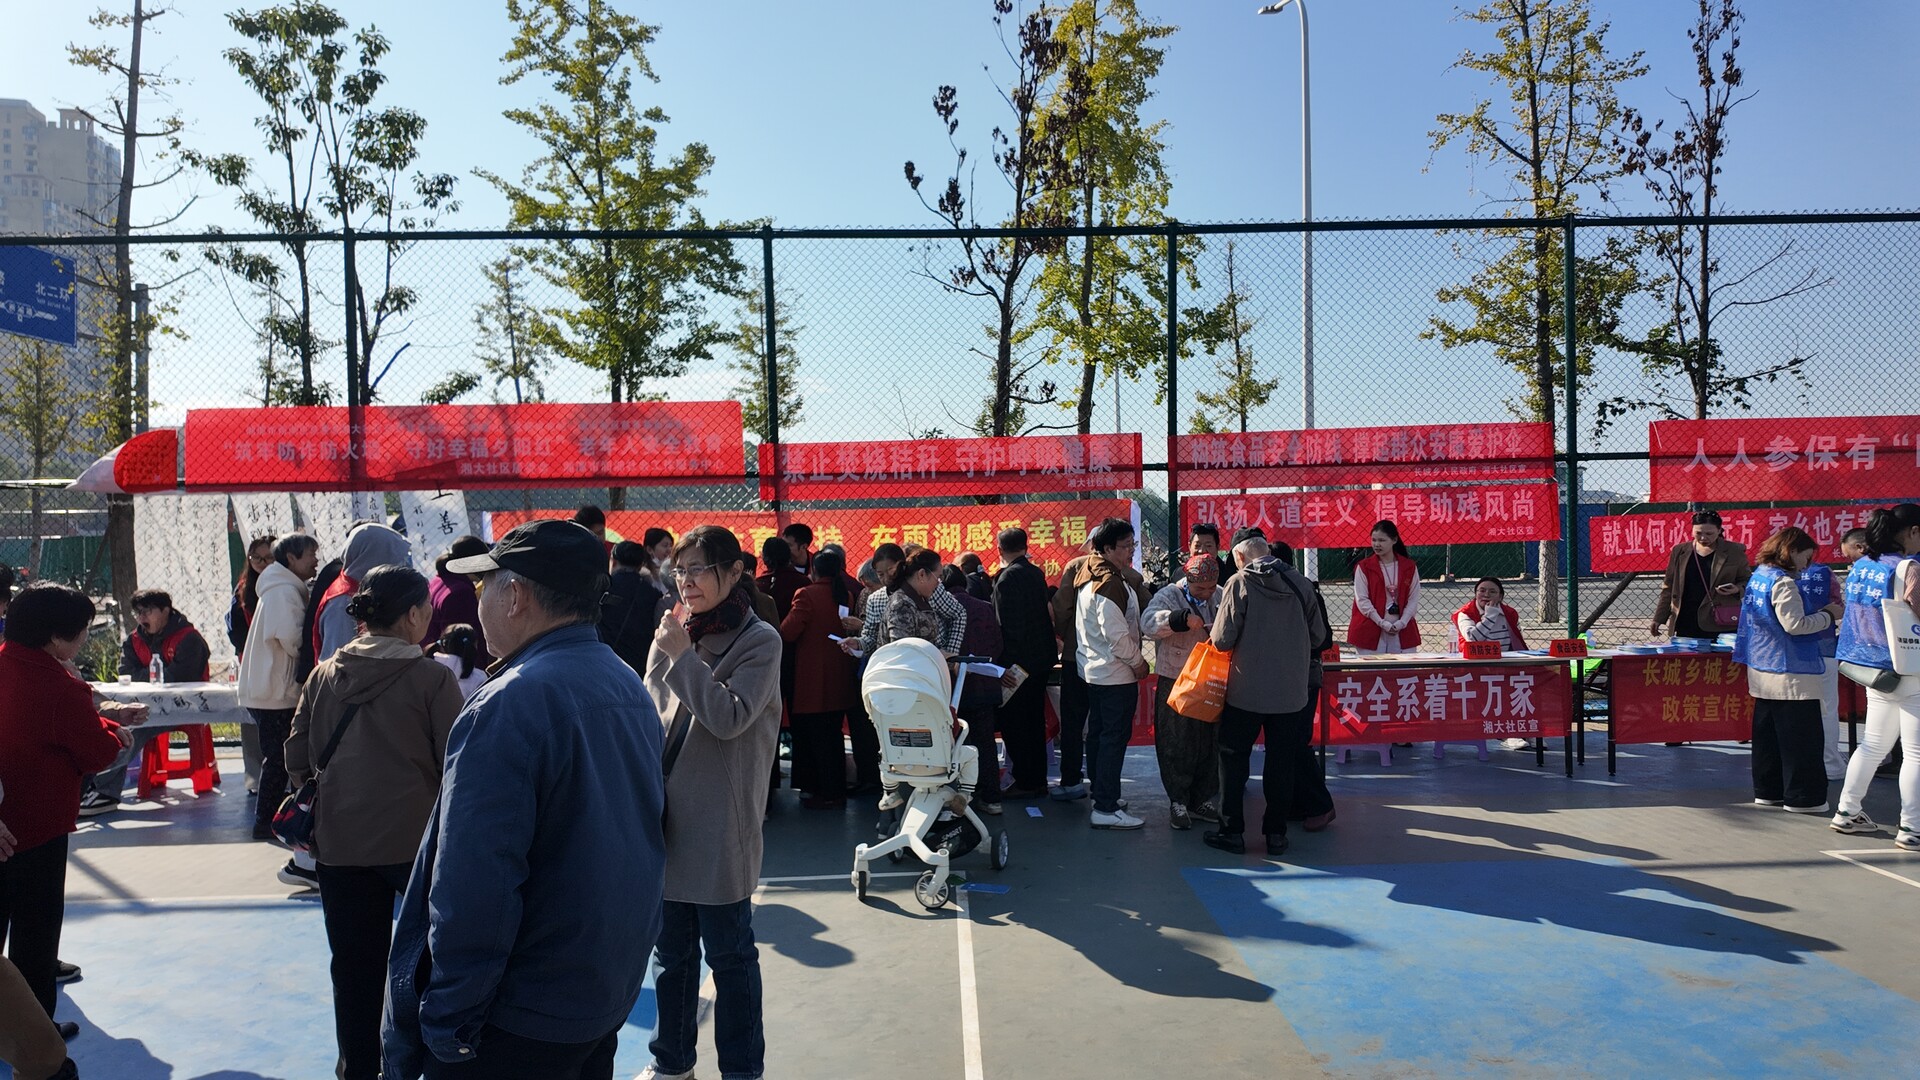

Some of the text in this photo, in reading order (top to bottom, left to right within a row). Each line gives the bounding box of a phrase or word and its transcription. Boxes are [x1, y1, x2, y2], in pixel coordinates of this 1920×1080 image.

[781, 439, 1113, 483] 禁止焚烧秸秆 守护呼吸健康
[1191, 432, 1343, 470] 构筑食品安全防线
[1197, 489, 1535, 530] 弘扬人道主义 倡导助残风尚
[1602, 514, 1755, 556] 就业何必方
[1642, 657, 1742, 686] 长城乡城乡
[1337, 671, 1536, 725] 安全系着千万家
[1482, 719, 1540, 734] 湘大社区宣
